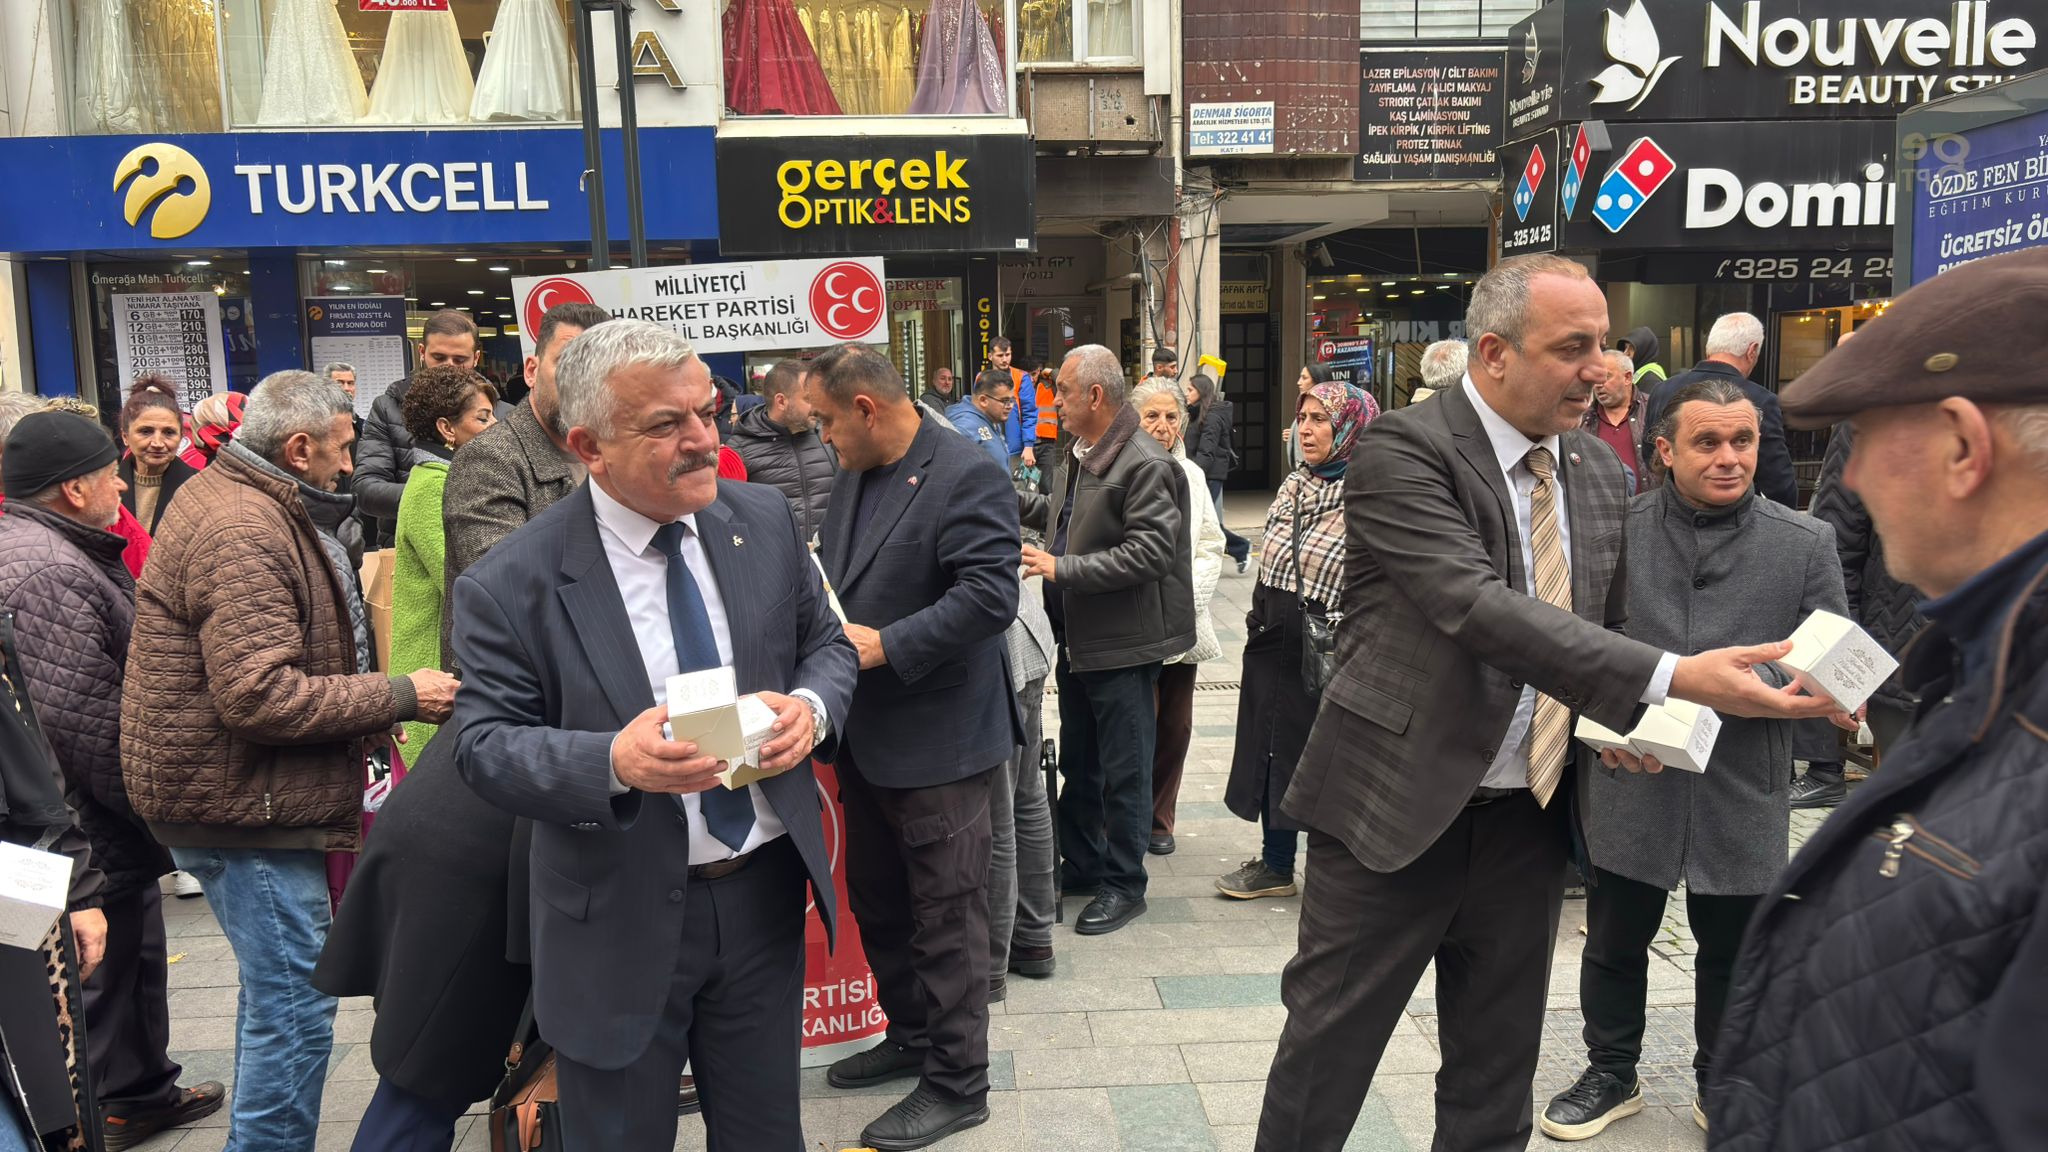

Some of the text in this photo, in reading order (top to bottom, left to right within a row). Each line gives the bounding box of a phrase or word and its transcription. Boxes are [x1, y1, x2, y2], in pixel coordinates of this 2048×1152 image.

[1705, 0, 2036, 67] Nouvelle
[1363, 68, 1390, 79] LAZER
[1393, 66, 1440, 79] EPİLASYON
[1448, 66, 1466, 78] CİLT
[1468, 67, 1498, 78] BAKIMI
[1369, 83, 1417, 93] ZAYIFLAMA
[1427, 82, 1455, 93] KALICI
[1457, 82, 1491, 93] MAKYAJ
[1793, 75, 1938, 104] BEAUTY
[1378, 96, 1482, 109] STRIORT ÇATLAK BAKIMI
[1192, 105, 1272, 119] DENMAR SİGORTA
[1390, 109, 1470, 123] KAŞ LAMİNASYONU
[1192, 130, 1272, 144] Tel: 322 41 41
[1368, 123, 1388, 136] İPEK
[1390, 123, 1419, 136] KİRPİK
[1427, 123, 1456, 135] KİRPİK
[1457, 122, 1491, 135] LİFTİNG
[1396, 139, 1462, 150] PROTEZ TIRNAK
[1363, 150, 1495, 166] SAĞLIKLI YAŞAM DANIŞMANLIĞI
[776, 150, 970, 196] gerçek
[1929, 170, 1978, 198] ÖZDE
[1983, 158, 2020, 188] FEN
[235, 161, 549, 214] TURKCELL
[1929, 186, 2048, 218] EĞİTİM KUR
[778, 195, 971, 228] OPTIK&LENS
[1513, 229, 1528, 247] 325
[1529, 226, 1540, 245] 24
[1540, 224, 1551, 242] 25
[1940, 218, 2023, 259] ÜCRETSİZ
[1733, 258, 1799, 279] 325
[1809, 257, 1853, 278] 24
[92, 273, 204, 286] Ömerağa Mah. Turkcell
[655, 271, 746, 297] MİLLİYETÇİ
[162, 295, 189, 303] ALANA
[163, 302, 200, 310] TAŞIYANA
[131, 311, 140, 321] 6
[611, 295, 795, 322] HAREKET PARTİSİ
[346, 321, 369, 329] SONRA
[370, 320, 387, 328] ÖDE!
[703, 317, 809, 341] BAŞKANLIĞI
